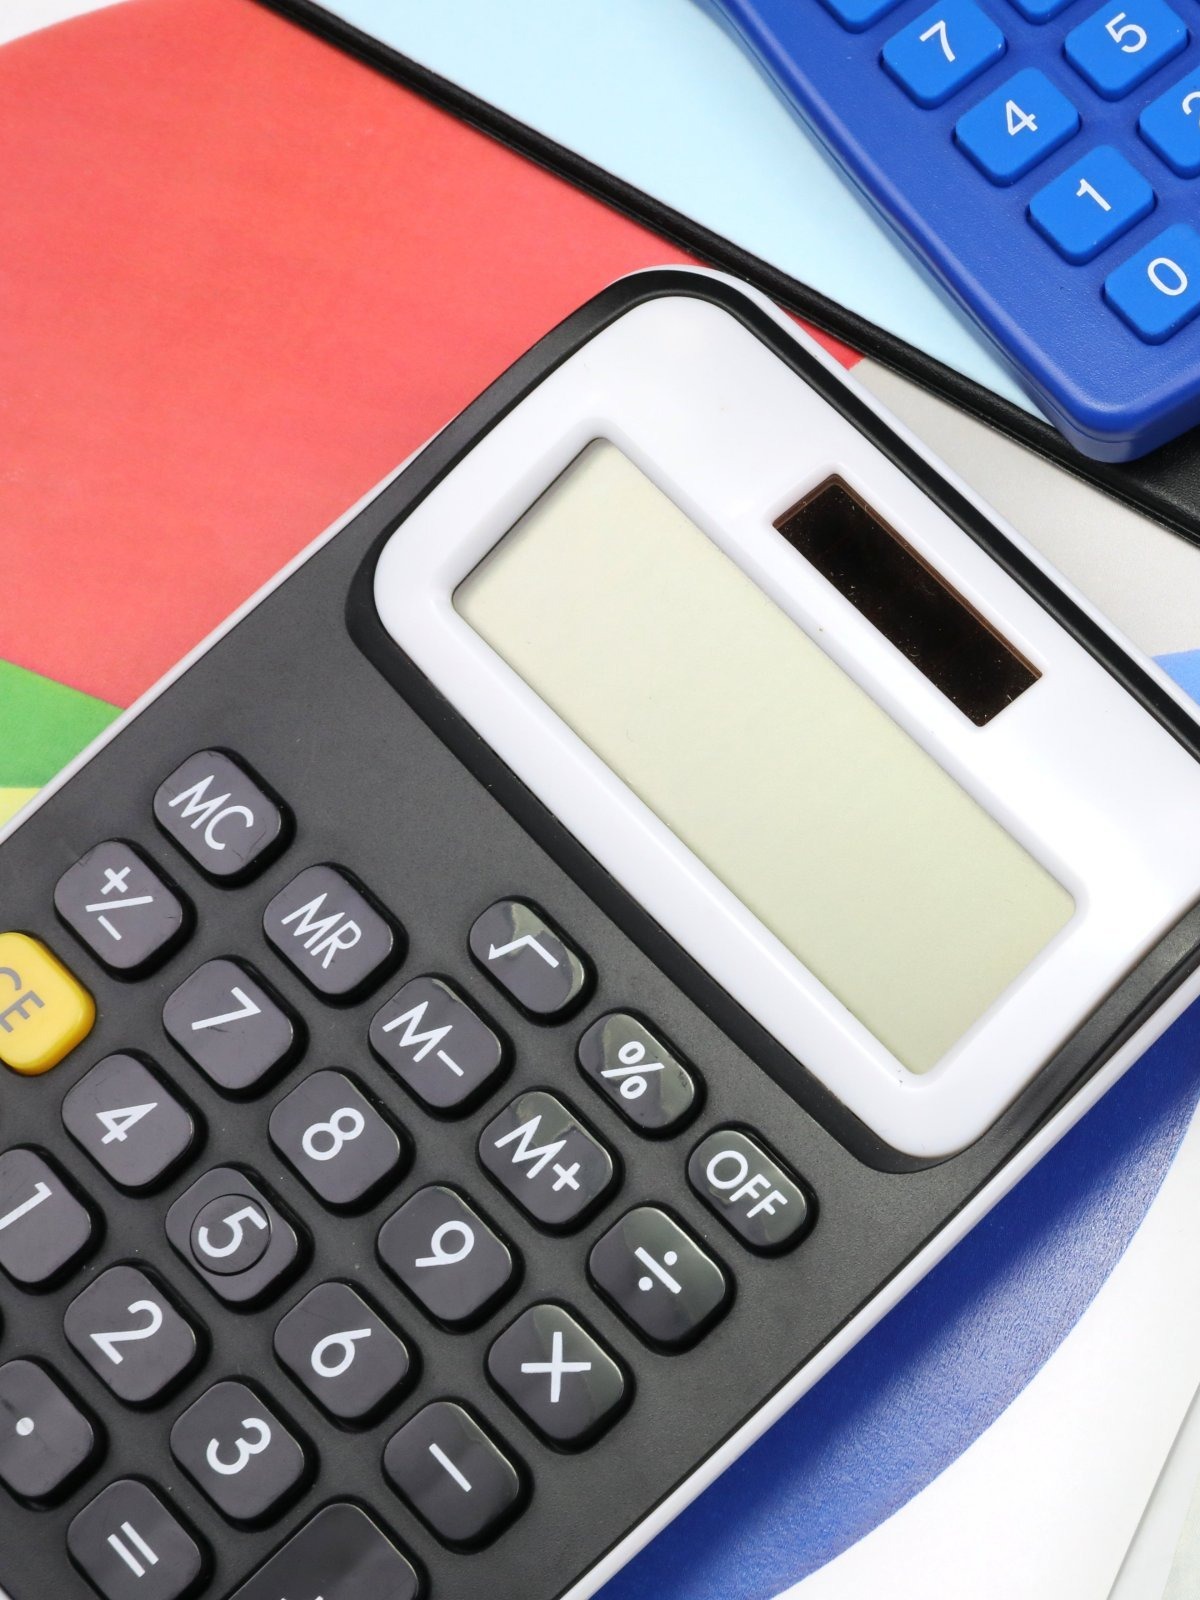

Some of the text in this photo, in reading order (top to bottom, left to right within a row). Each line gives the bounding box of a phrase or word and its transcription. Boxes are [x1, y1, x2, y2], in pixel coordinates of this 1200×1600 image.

[919, 20, 956, 63] 7
[1105, 12, 1149, 54] 5
[1002, 99, 1038, 137] 4
[1075, 178, 1113, 213] 1
[1147, 257, 1189, 297] 0
[167, 773, 255, 851] MC
[280, 891, 362, 970] MR
[191, 986, 262, 1031] 7
[95, 1100, 788, 1222] 4 8 M+ OFF
[0, 1181, 53, 1230] 1
[198, 1204, 270, 1258] 5
[415, 1220, 476, 1268] 9
[91, 1299, 163, 1365] 2
[310, 1327, 372, 1377] 6
[205, 1415, 273, 1476] 3
